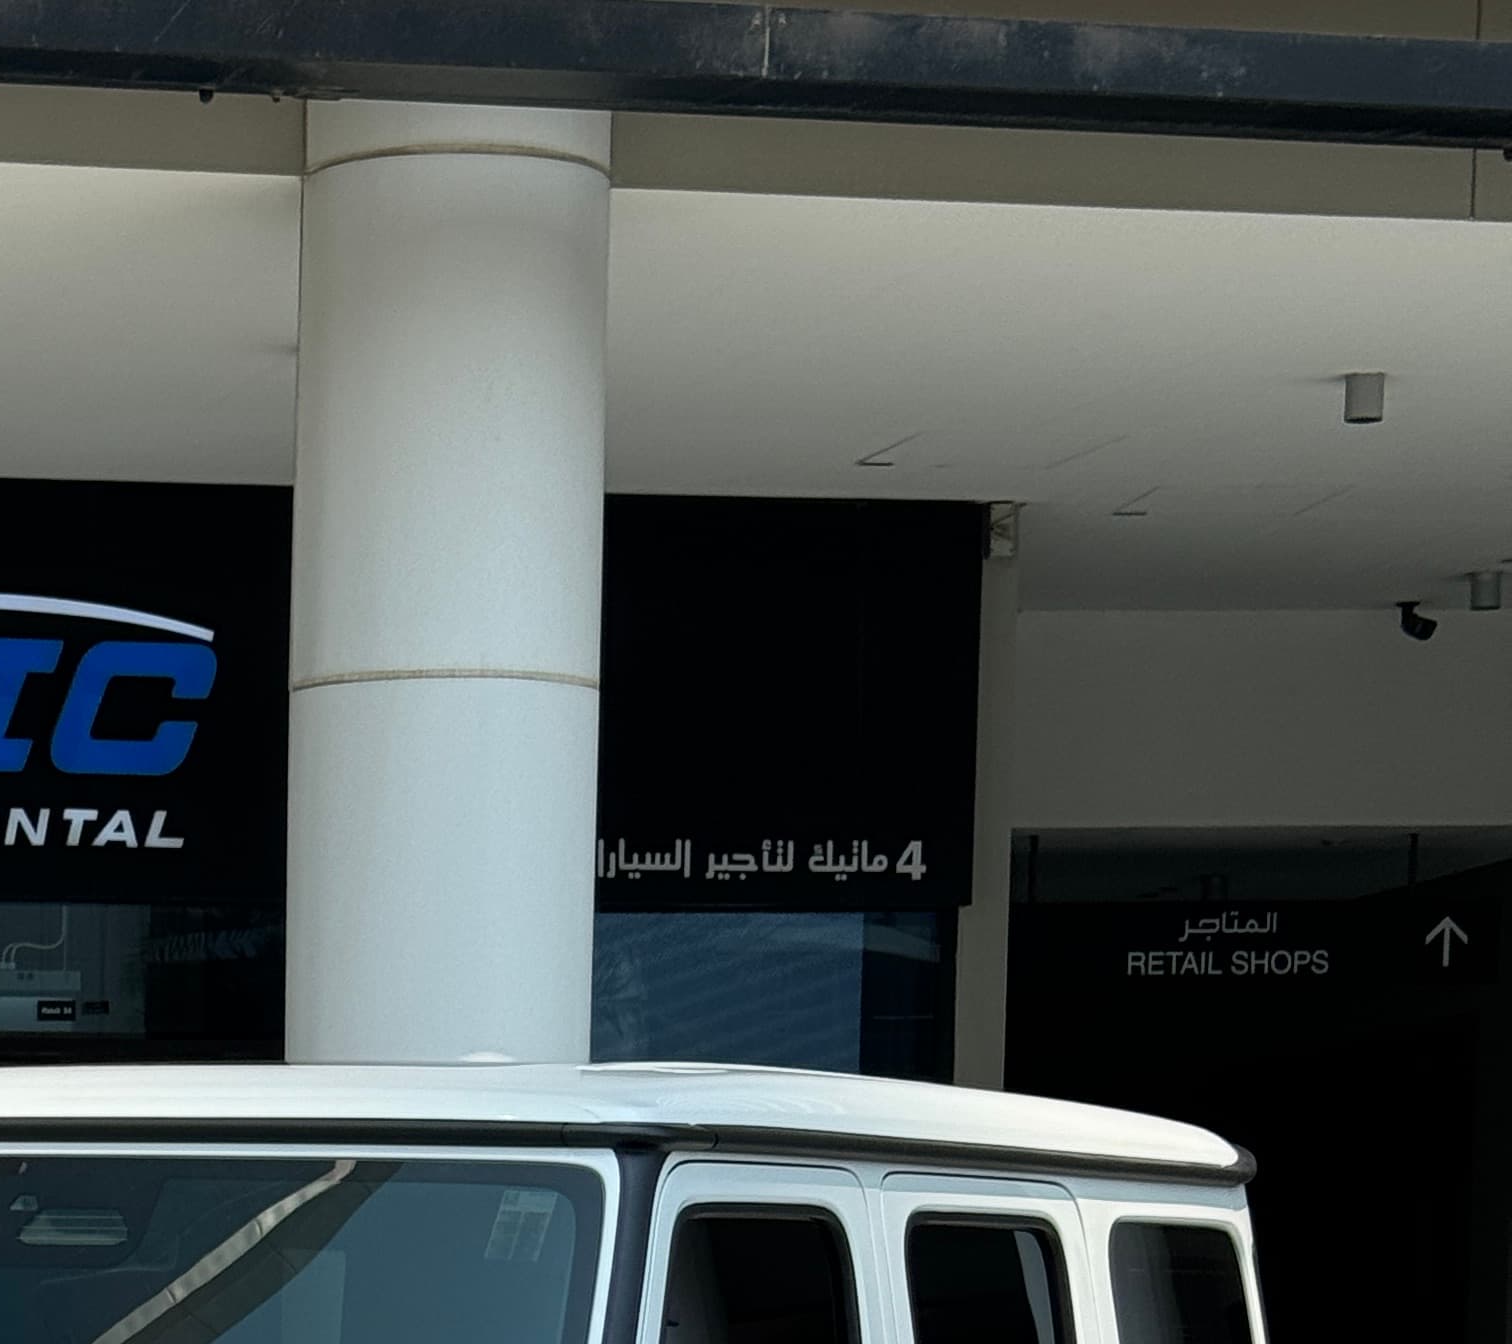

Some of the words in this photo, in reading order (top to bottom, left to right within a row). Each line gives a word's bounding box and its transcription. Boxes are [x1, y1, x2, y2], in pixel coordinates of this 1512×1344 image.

[597, 837, 692, 879] السيارا
[807, 839, 889, 882] ماتيك
[895, 839, 927, 881] 4
[1178, 910, 1278, 942] المتاجر
[1126, 950, 1223, 976] RETAIL
[1230, 949, 1330, 975] SHOPS
